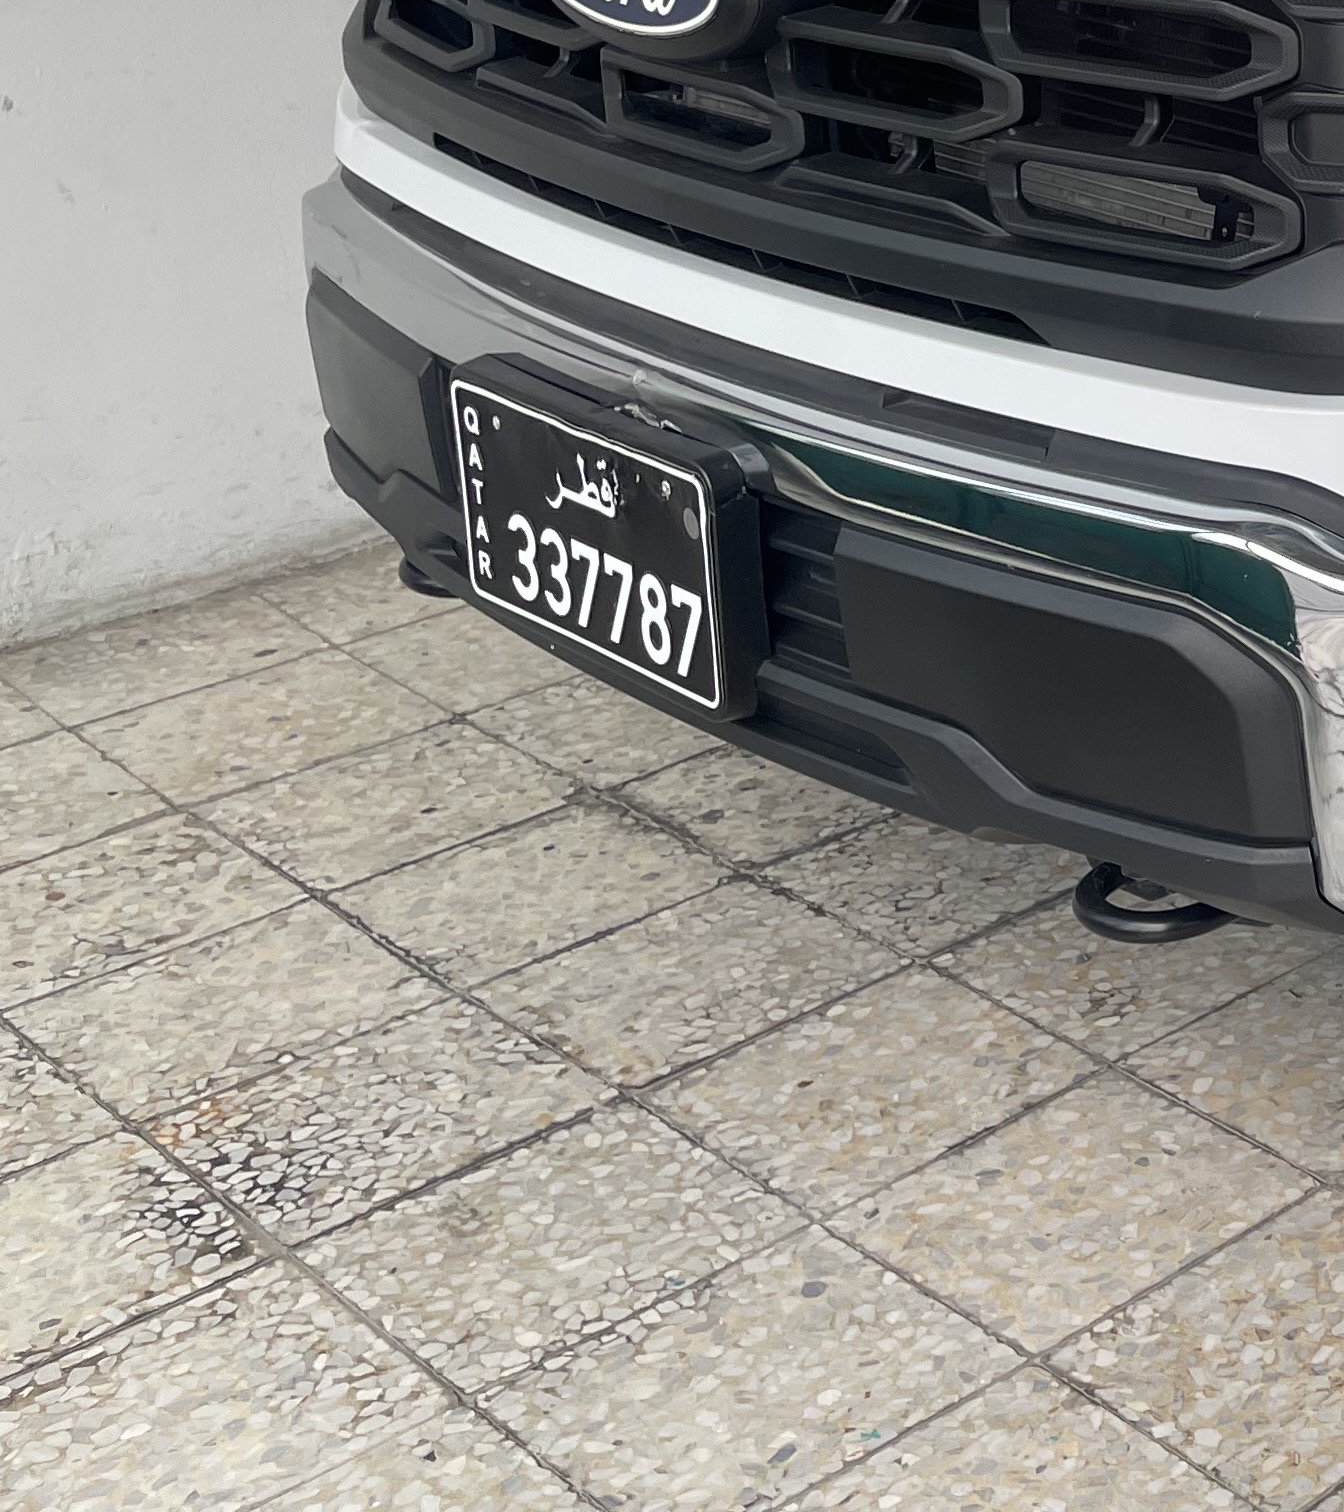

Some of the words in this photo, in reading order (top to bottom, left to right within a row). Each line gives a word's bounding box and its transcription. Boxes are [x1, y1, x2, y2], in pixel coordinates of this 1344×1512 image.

[463, 406, 493, 580] QATAR
[545, 452, 617, 518] قطر
[507, 513, 702, 677] 337787
